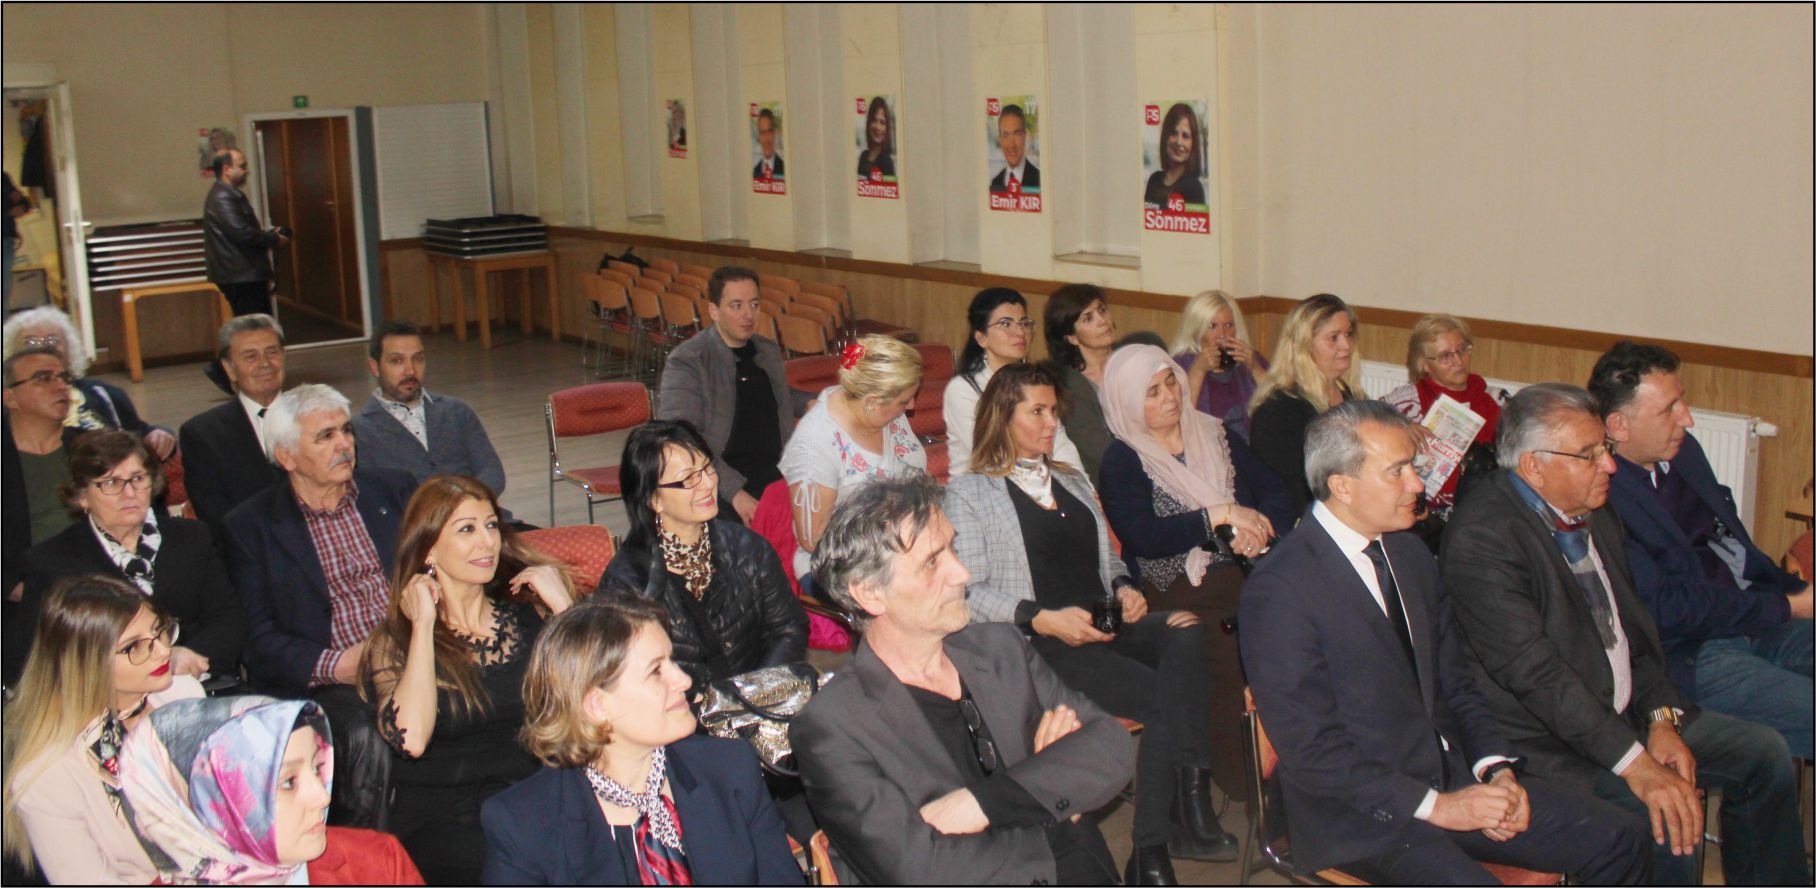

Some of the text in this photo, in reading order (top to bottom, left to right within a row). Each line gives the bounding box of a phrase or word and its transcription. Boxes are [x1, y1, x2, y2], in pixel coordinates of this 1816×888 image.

[1146, 109, 1159, 121] PS
[857, 180, 897, 198] Sönmez
[991, 194, 1040, 210] Emir KIR
[1145, 210, 1208, 232] Sönmez
